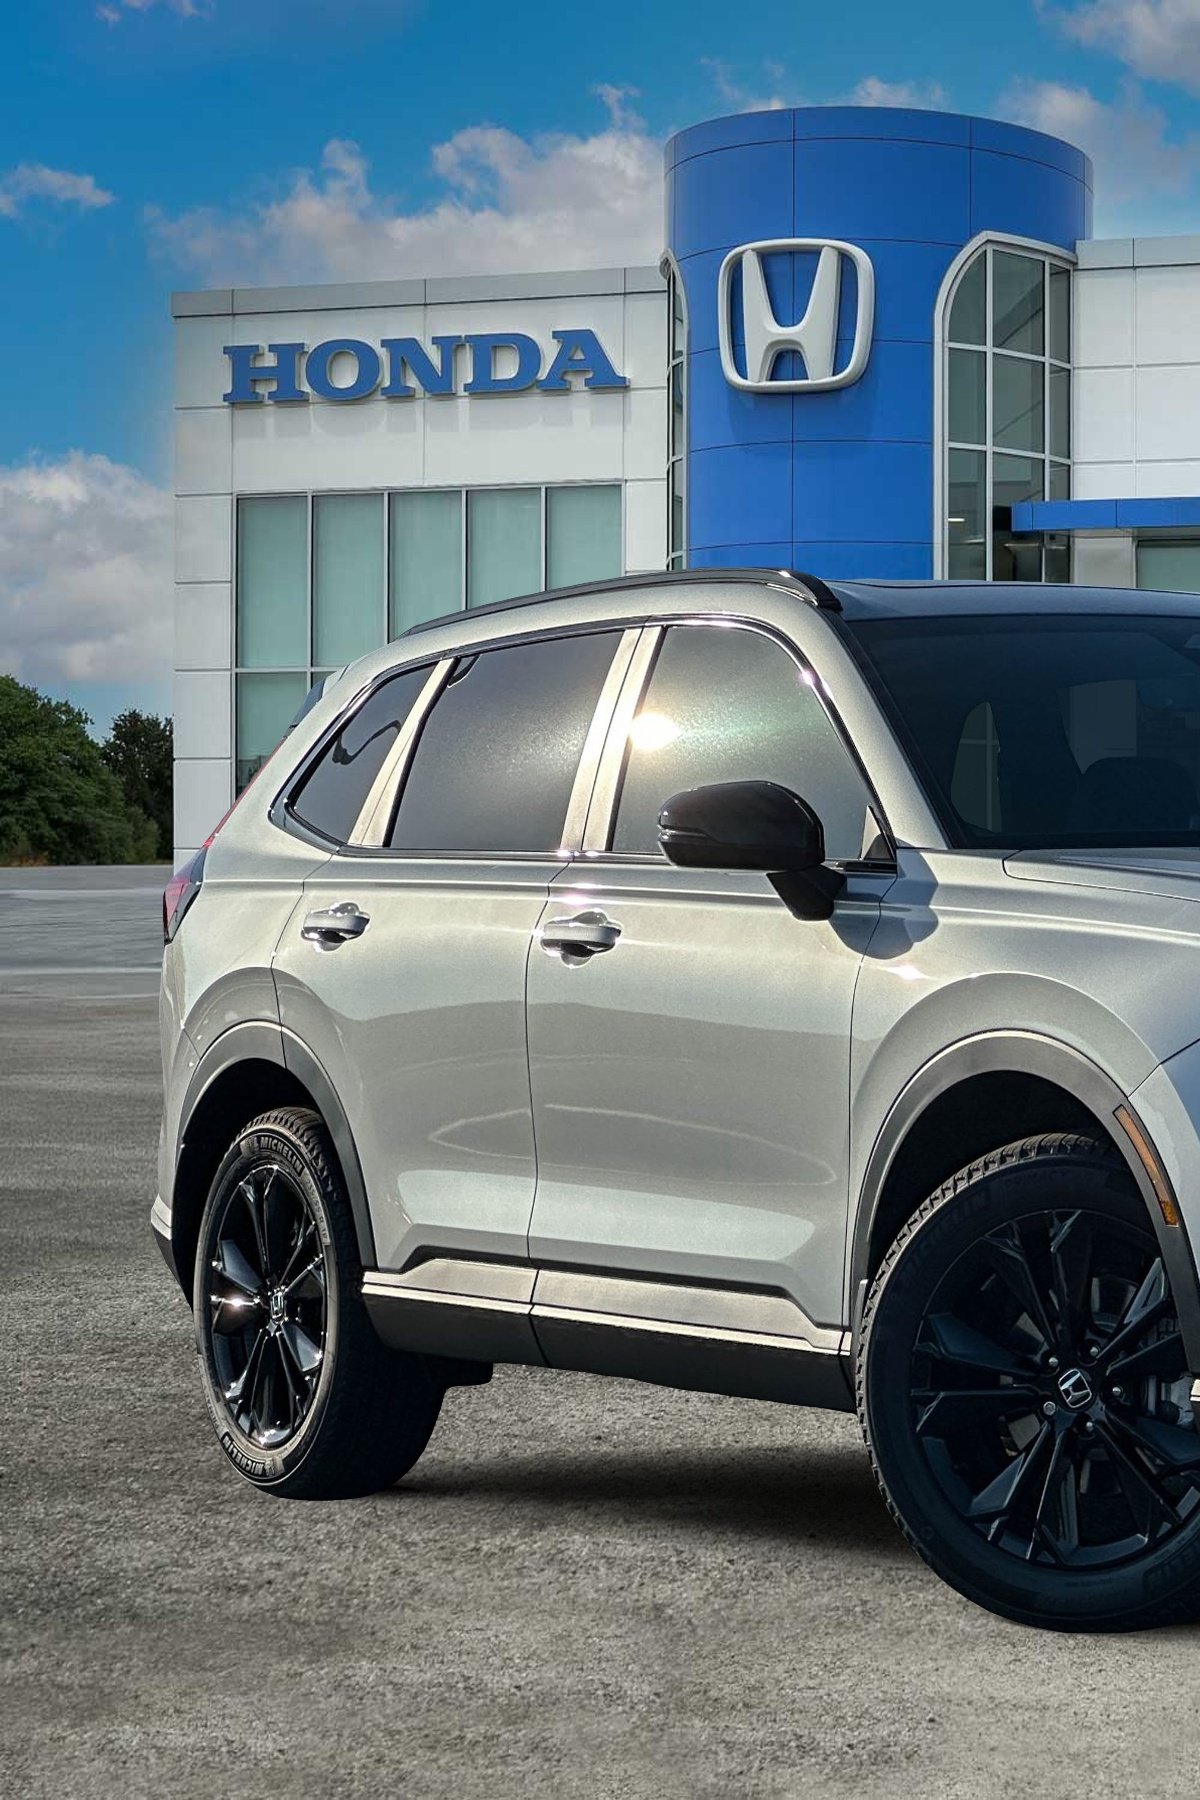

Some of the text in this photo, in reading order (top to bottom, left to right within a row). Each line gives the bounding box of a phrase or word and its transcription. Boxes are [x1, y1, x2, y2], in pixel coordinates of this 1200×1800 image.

[222, 328, 631, 405] HONDA
[260, 1135, 303, 1174] MICHELIN
[222, 1434, 264, 1476] MICHELIN
